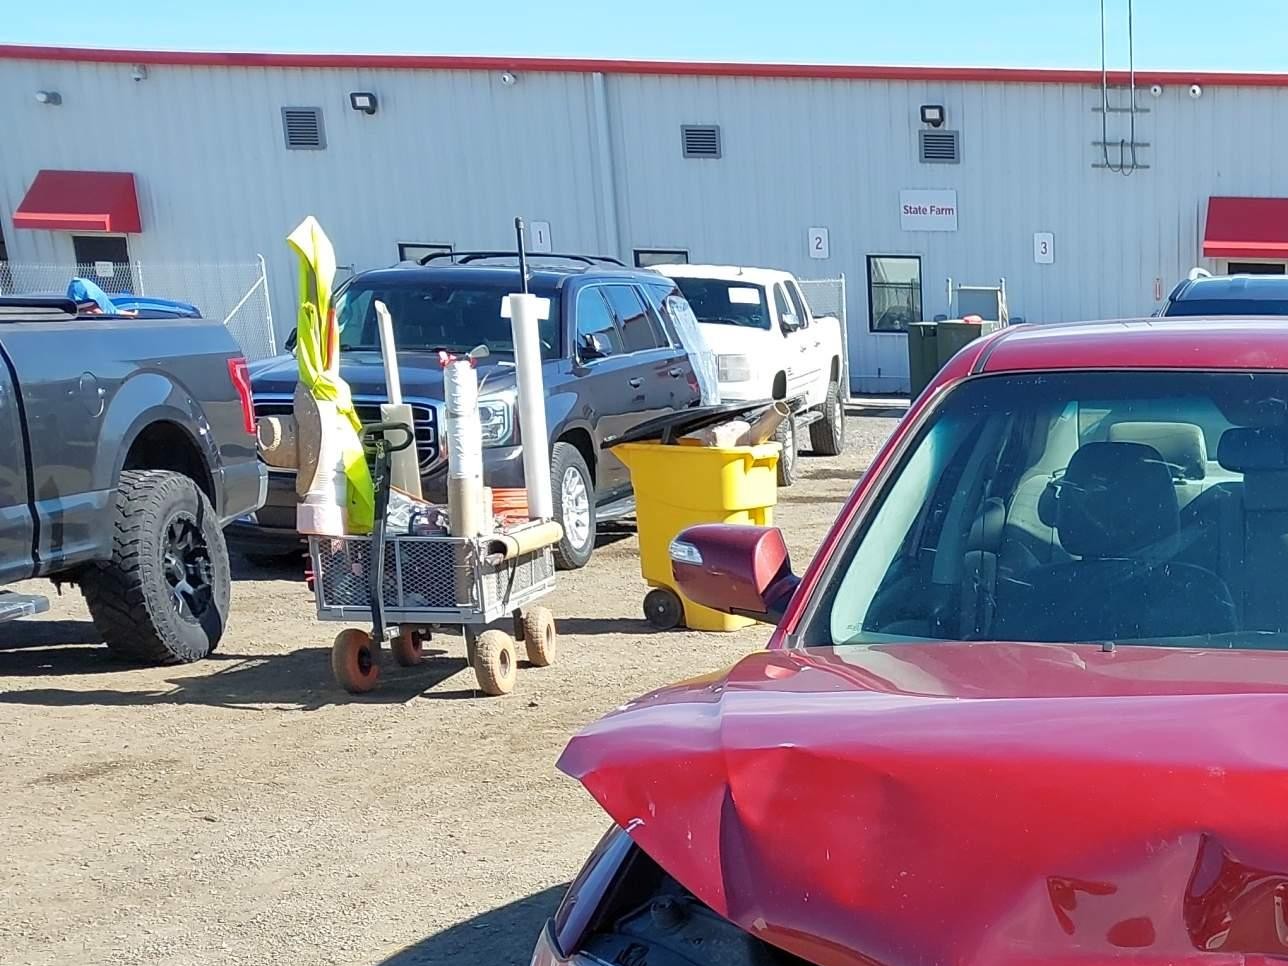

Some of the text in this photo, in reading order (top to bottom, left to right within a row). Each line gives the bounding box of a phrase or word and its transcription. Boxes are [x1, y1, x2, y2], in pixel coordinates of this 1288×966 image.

[903, 205, 954, 215] State Farm
[538, 230, 543, 244] 1
[815, 236, 823, 250] 2
[1040, 241, 1048, 255] 3
